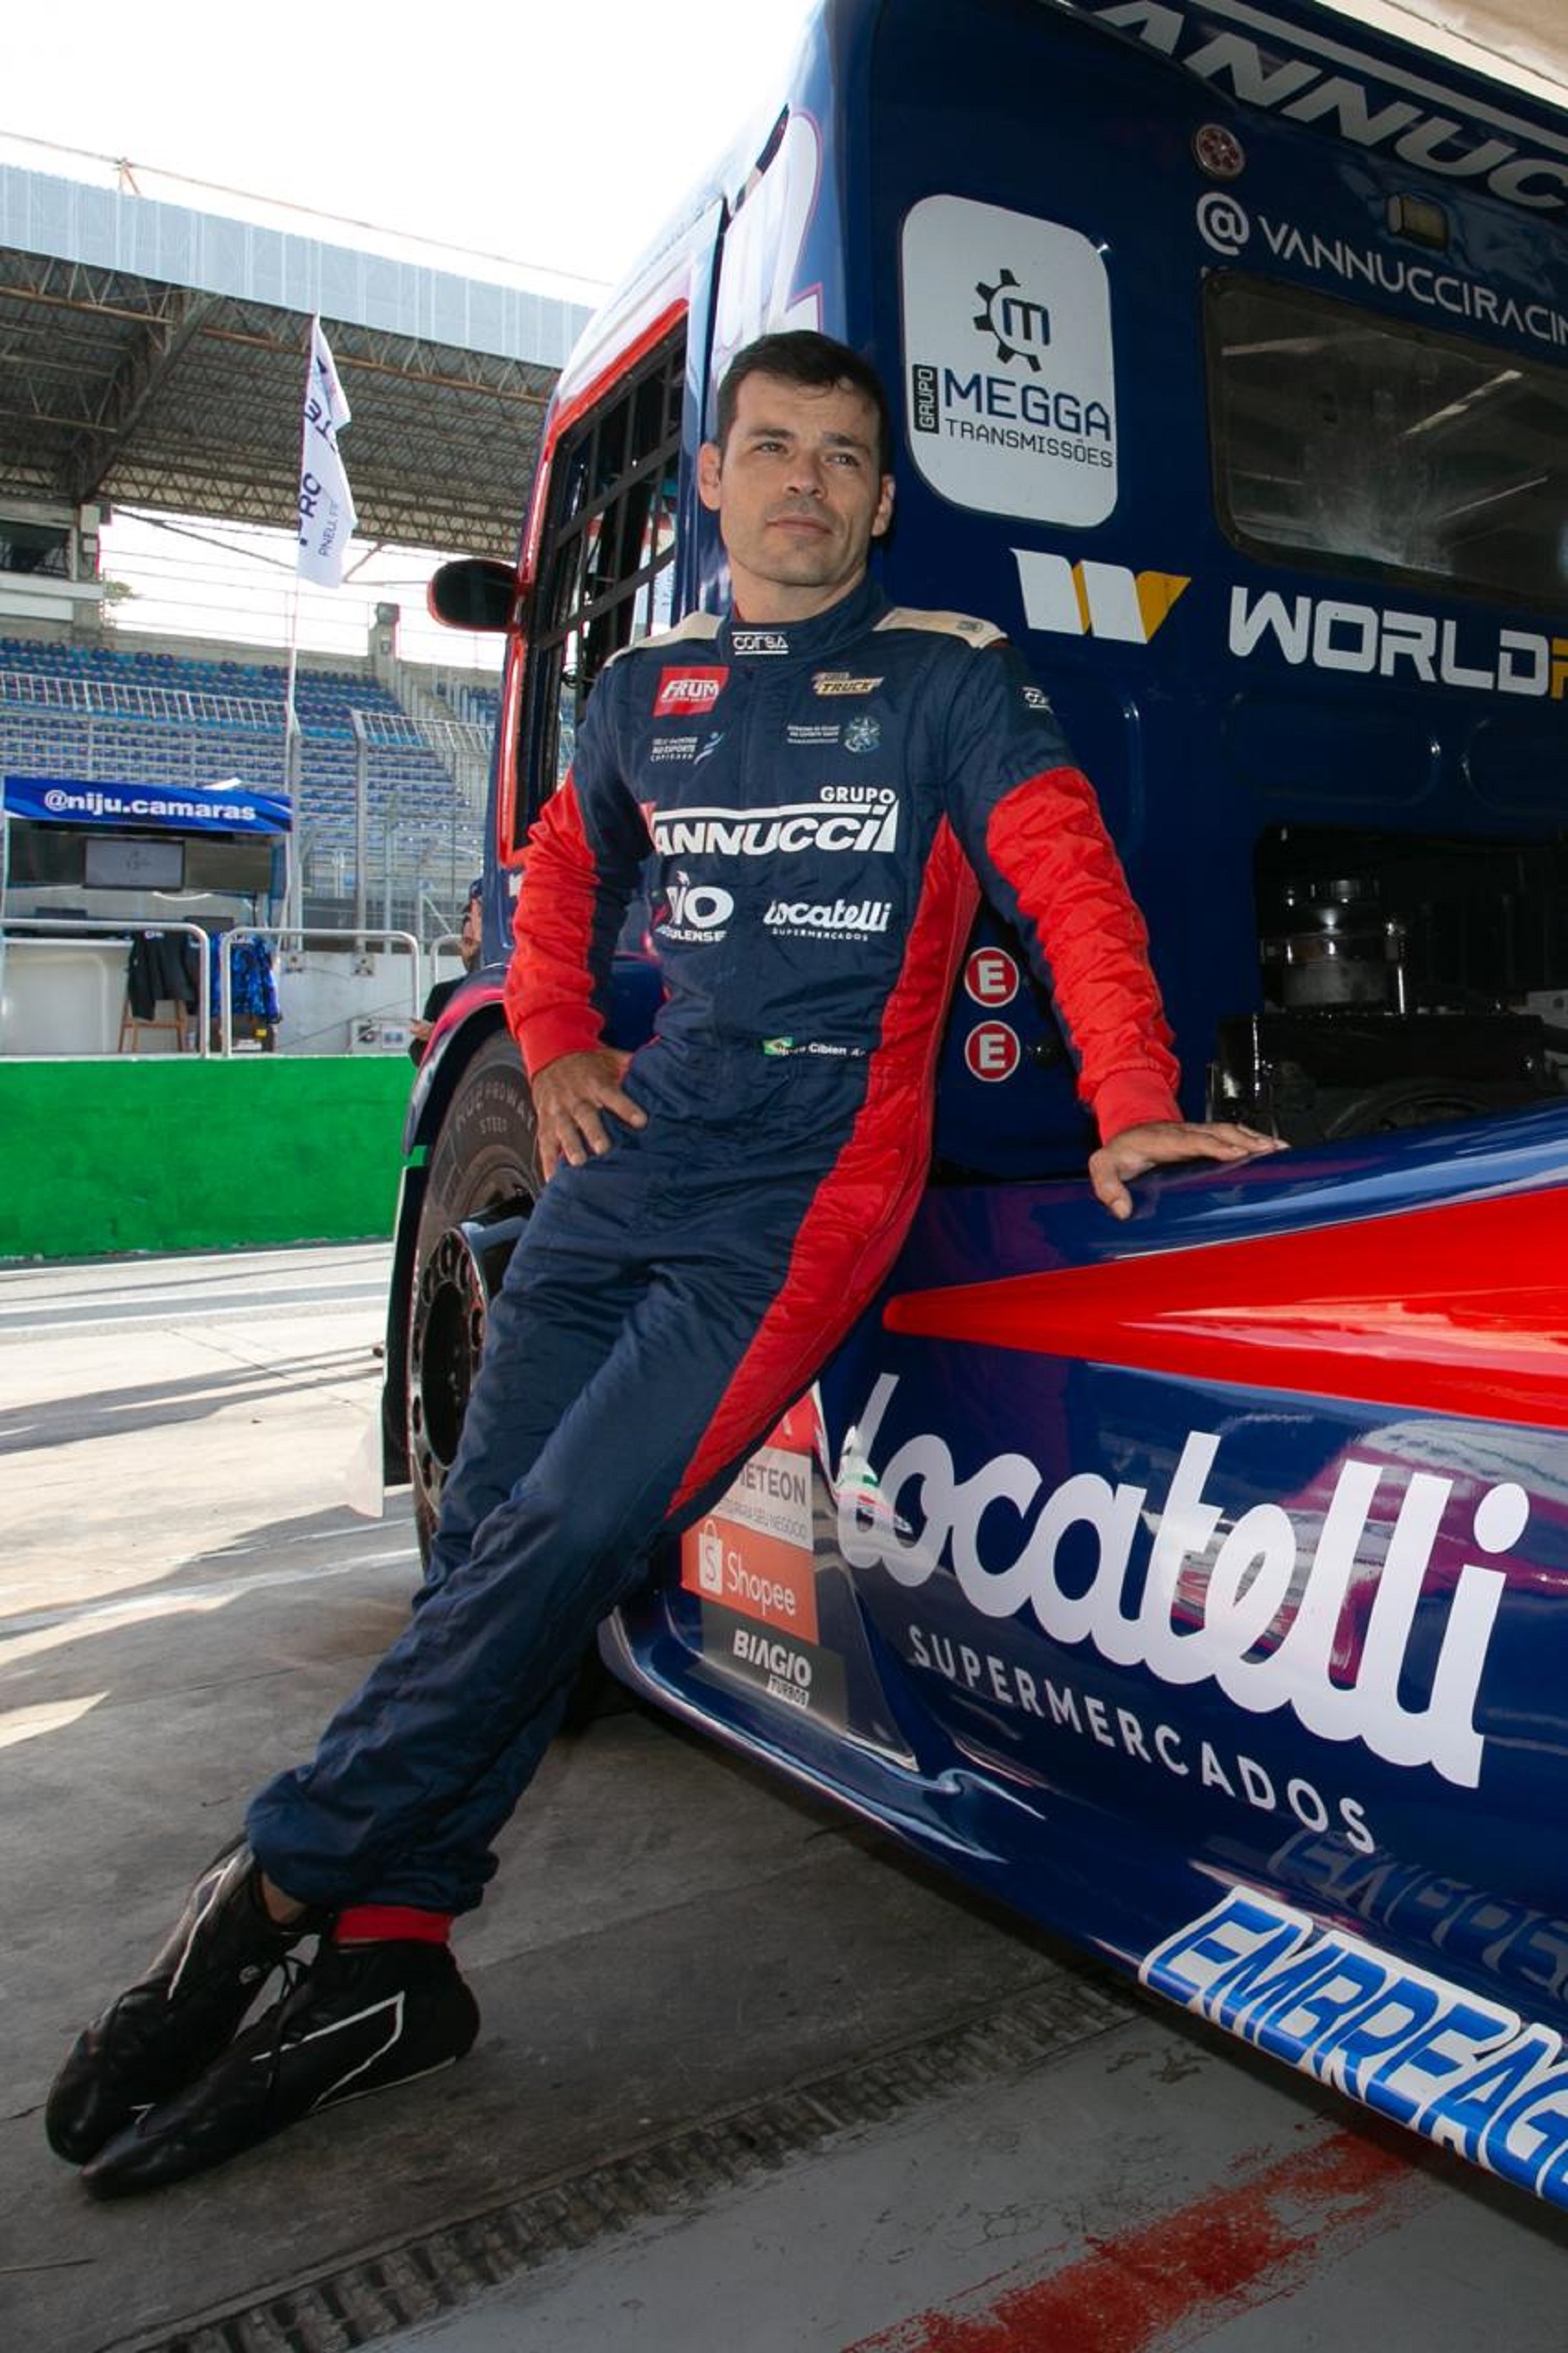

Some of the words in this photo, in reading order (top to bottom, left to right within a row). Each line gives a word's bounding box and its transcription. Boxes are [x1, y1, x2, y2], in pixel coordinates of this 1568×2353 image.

[917, 368, 935, 429] GRUPO
[944, 367, 1111, 442] MEGGA
[944, 418, 1114, 469] TRANSMISSÕES
[1228, 585, 1568, 700] WORLD
[661, 679, 720, 700] FRUM
[44, 789, 256, 821] @niju.camaras
[820, 786, 896, 804] GRUPO
[977, 959, 1006, 994] E
[979, 1033, 1006, 1069] E
[727, 1552, 796, 1616] Shopee
[733, 1629, 813, 1687] BIAGIO
[909, 1624, 1375, 1854] SUPERMERCADOS
[1139, 1886, 1568, 2211] EMBREAG
